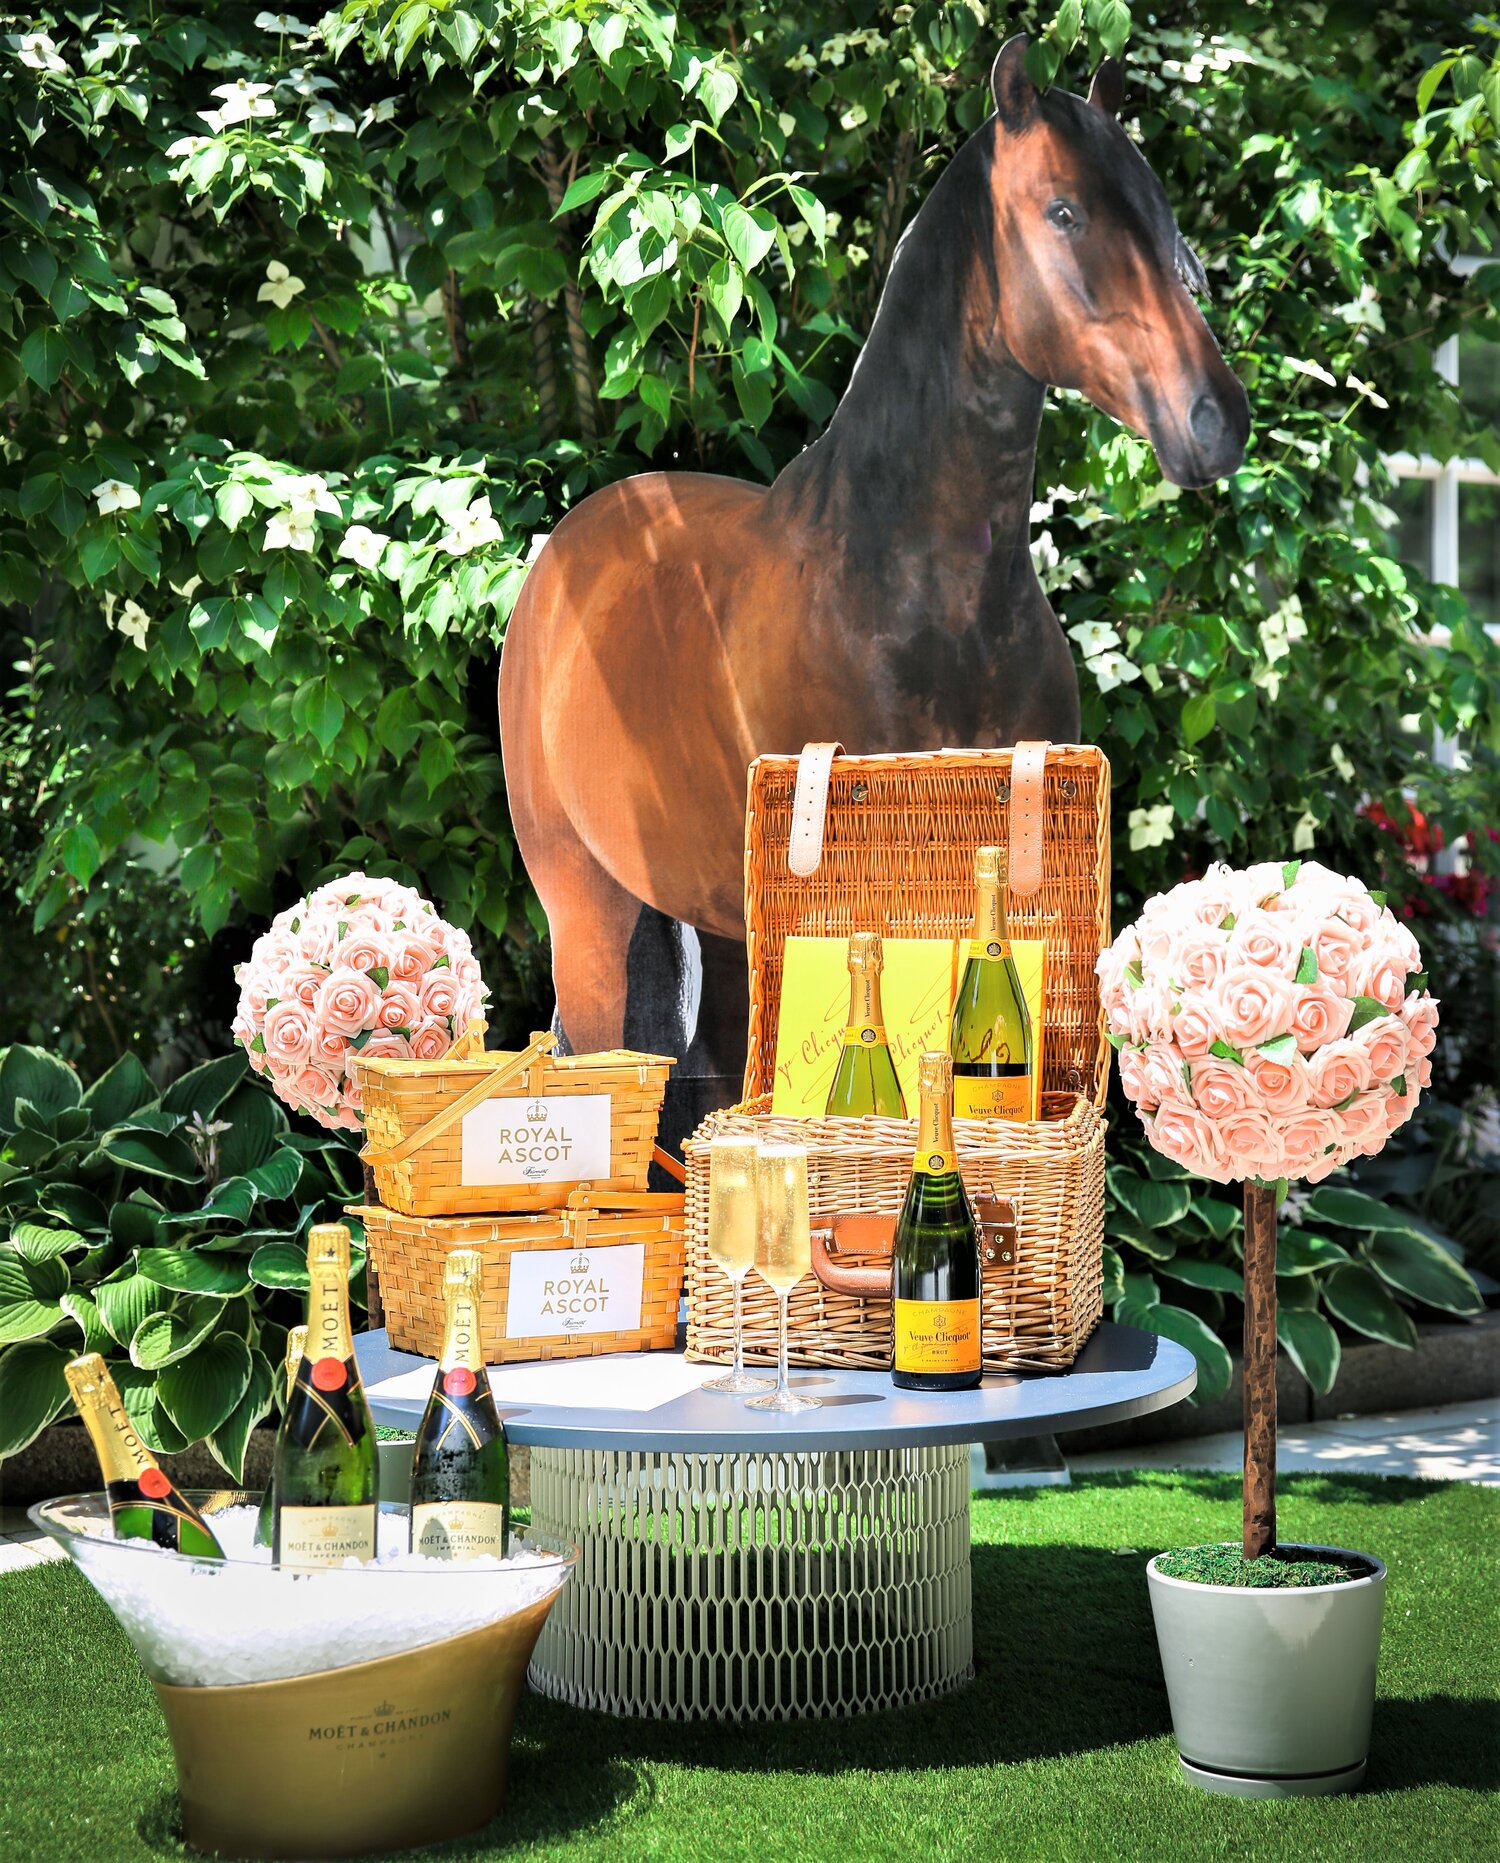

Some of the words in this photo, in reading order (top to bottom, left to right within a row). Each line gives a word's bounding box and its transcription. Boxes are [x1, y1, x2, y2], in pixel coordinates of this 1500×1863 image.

[864, 979, 872, 1002] Clicquot
[932, 1103, 940, 1126] Clicquot
[968, 1104, 992, 1115] Veuve
[993, 1104, 1025, 1116] Clicquot
[499, 1126, 573, 1145] ROYAL
[498, 1145, 573, 1165] ASCOT
[543, 1277, 610, 1297] ROYAL
[540, 1296, 609, 1316] ASCOT
[909, 1330, 934, 1342] Veuve
[935, 1330, 971, 1343] Clicquot
[324, 1540, 369, 1551] CHANDON
[450, 1534, 497, 1545] CHANDON
[308, 1724, 358, 1741] MOËT
[360, 1726, 370, 1737] &
[373, 1708, 452, 1736] CHANDON
